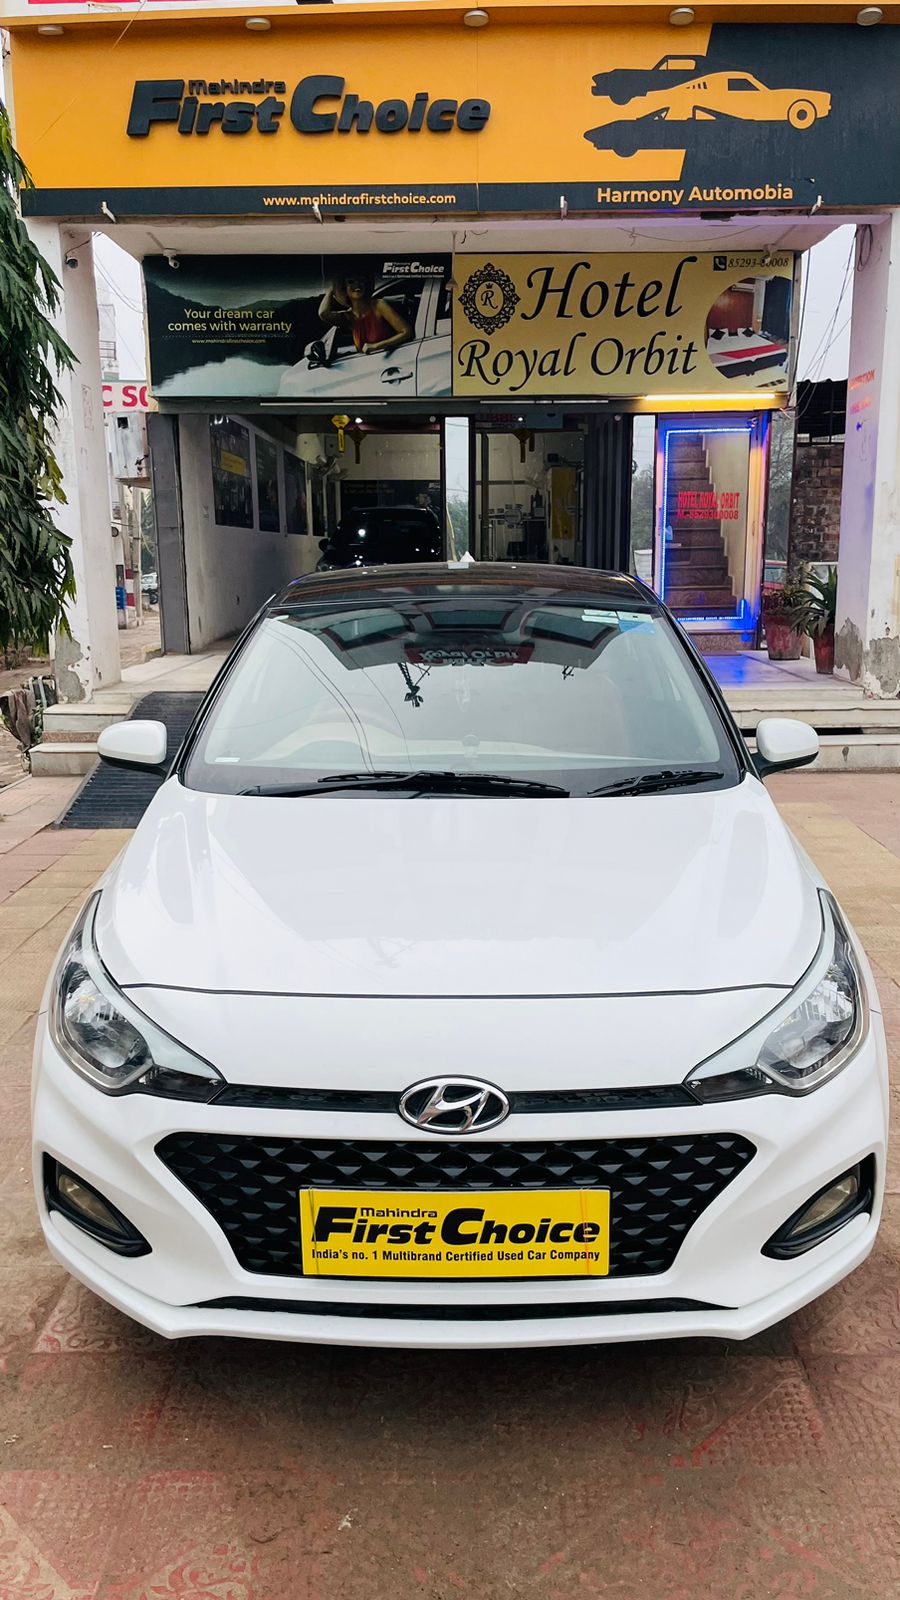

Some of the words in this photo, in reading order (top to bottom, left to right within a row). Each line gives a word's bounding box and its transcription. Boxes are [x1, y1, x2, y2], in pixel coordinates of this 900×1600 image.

[188, 79, 286, 95] Mahindra
[126, 79, 286, 137] First
[290, 74, 491, 134] Choice
[263, 192, 456, 206] www.mahindrafirstchoice.com
[597, 187, 683, 205] Harmony
[688, 184, 794, 202] Automobia
[382, 262, 410, 273] First
[410, 261, 445, 273] Choice
[520, 255, 698, 320] Hotel
[183, 308, 212, 320] Your
[214, 308, 253, 320] dream
[256, 310, 275, 320] car
[168, 322, 207, 332] comes
[209, 320, 236, 332] with
[239, 321, 292, 334] warranty
[458, 331, 587, 391] Royal
[590, 331, 698, 377] Orbit
[721, 492, 740, 508] ORBIT
[360, 1207, 438, 1218] Mahindra
[311, 1206, 438, 1245] First
[441, 1208, 600, 1246] Choice
[312, 1249, 349, 1260] India's
[352, 1251, 368, 1260] no.
[372, 1250, 378, 1260] 1
[382, 1250, 442, 1262] Multibrand
[446, 1250, 493, 1262] Certified
[497, 1250, 524, 1262] Used
[527, 1250, 547, 1261] Car
[550, 1249, 600, 1262] Company
